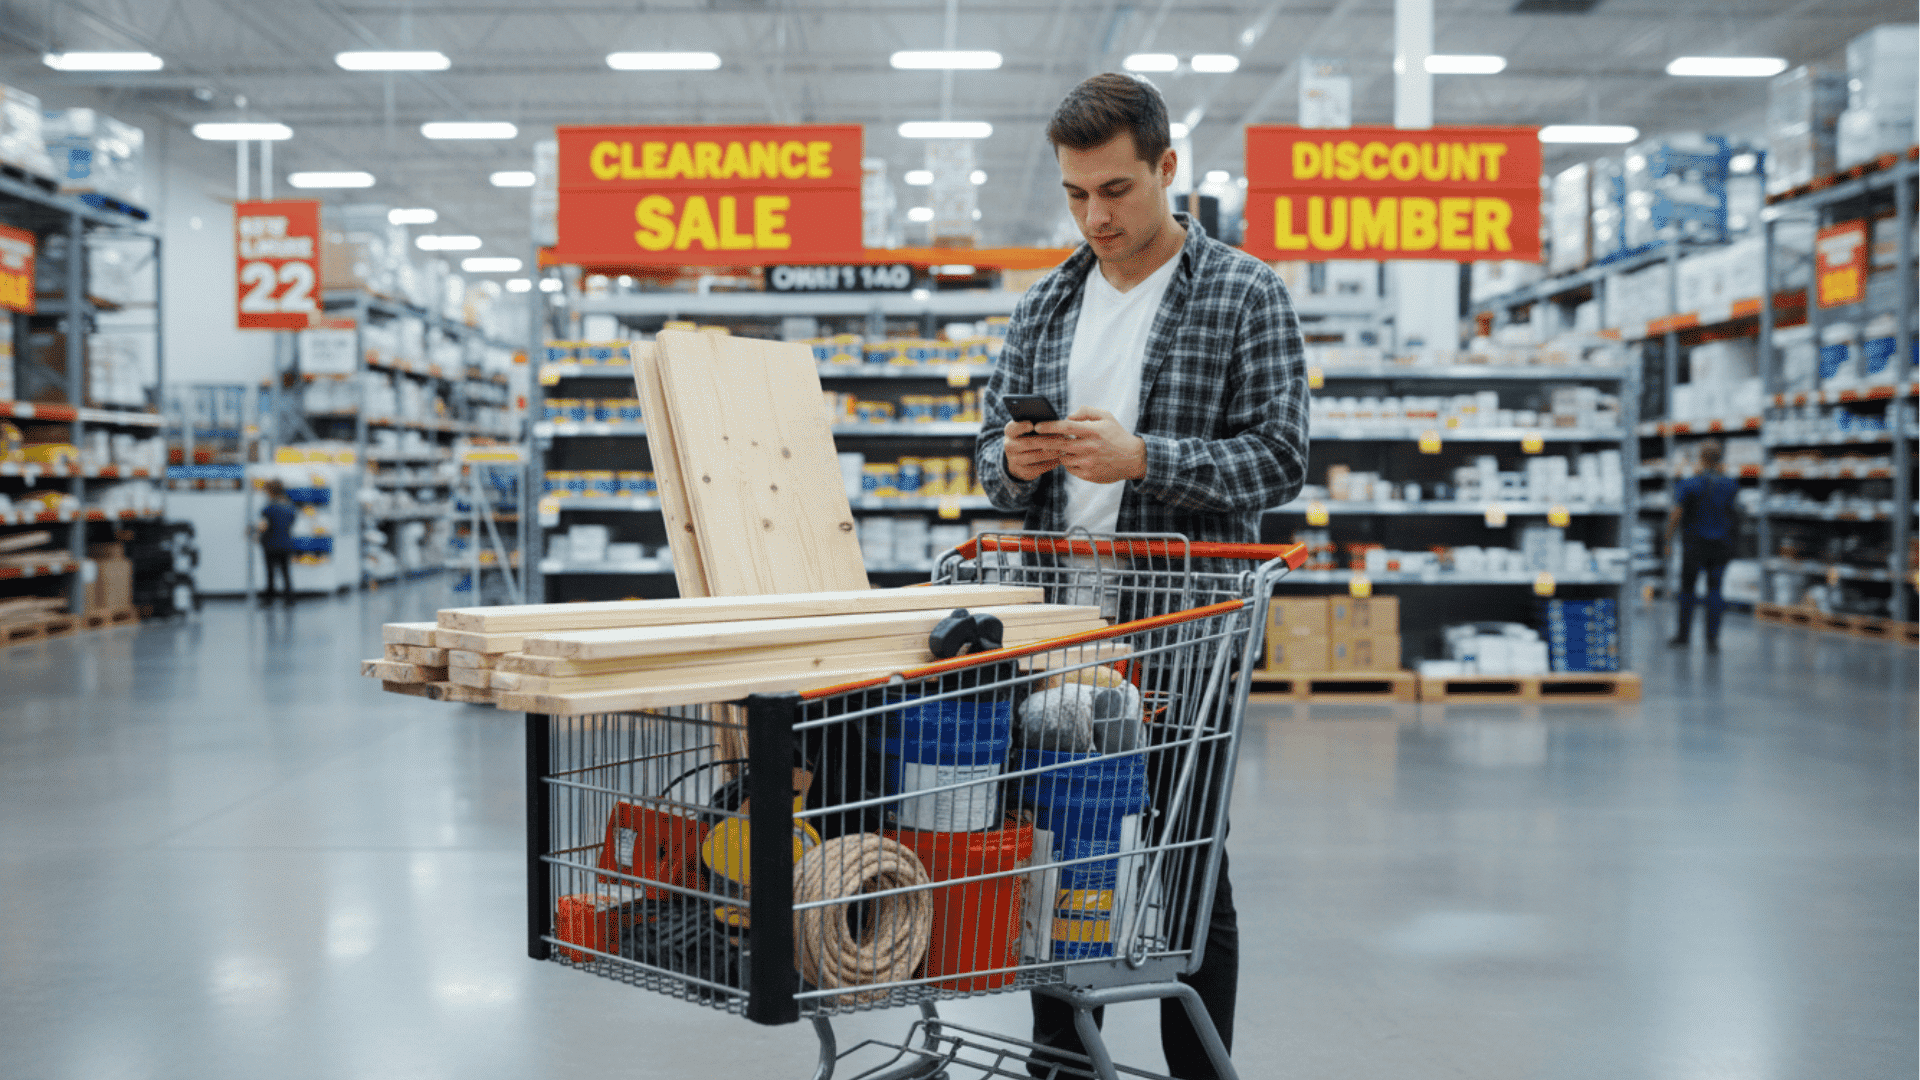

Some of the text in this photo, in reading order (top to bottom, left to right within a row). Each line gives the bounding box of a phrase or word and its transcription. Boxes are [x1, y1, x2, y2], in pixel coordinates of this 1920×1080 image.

[591, 141, 832, 180] CLEARANCE
[1292, 141, 1507, 181] DISCOUNT
[635, 195, 792, 251] SALE
[1275, 196, 1512, 251] LUMBER
[240, 261, 316, 313] 22
